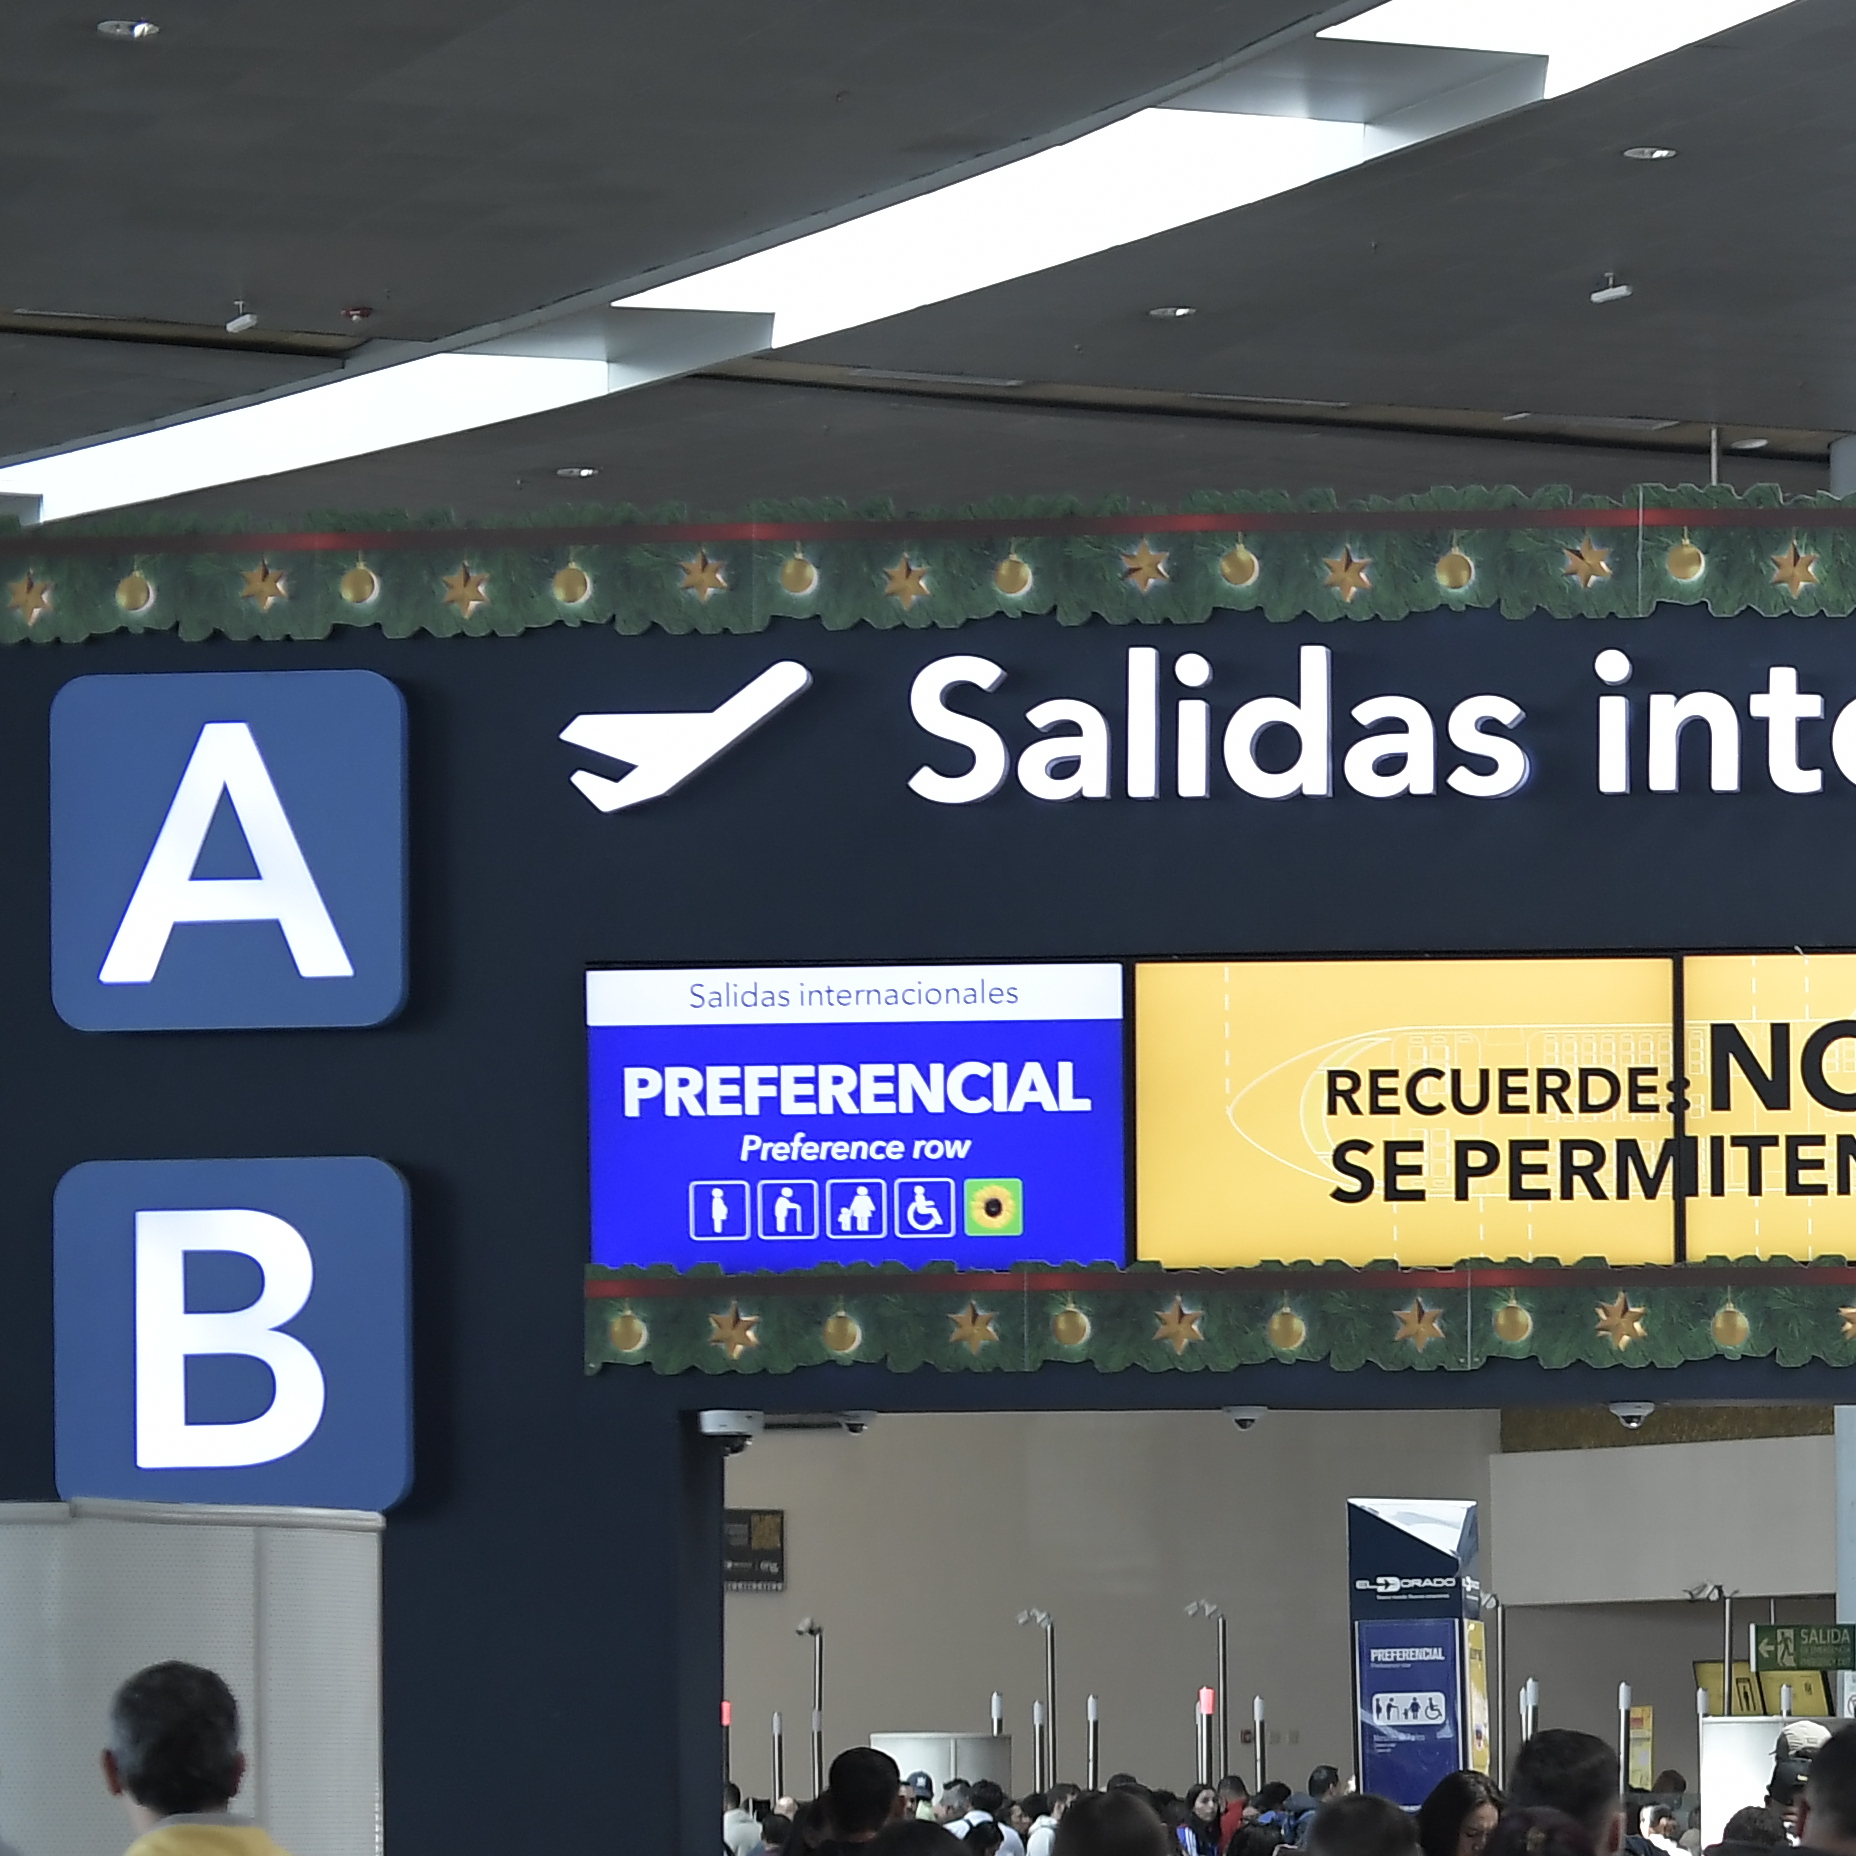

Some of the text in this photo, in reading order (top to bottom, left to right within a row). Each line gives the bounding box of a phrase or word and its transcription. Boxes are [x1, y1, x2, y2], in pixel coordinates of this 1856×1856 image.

[905, 644, 1530, 805] Salidas
[98, 721, 355, 984] A
[690, 979, 1020, 1010] Salidas internacionales
[623, 1061, 1093, 1118] PREFERENCIAL
[1326, 1068, 1691, 1117] RECUERDE:
[740, 1133, 972, 1163] Preference row
[1329, 1138, 1427, 1204] SE
[135, 1207, 327, 1470] B
[1370, 1647, 1445, 1662] PREFERENCIAL
[1800, 1628, 1851, 1645] SALIDA
